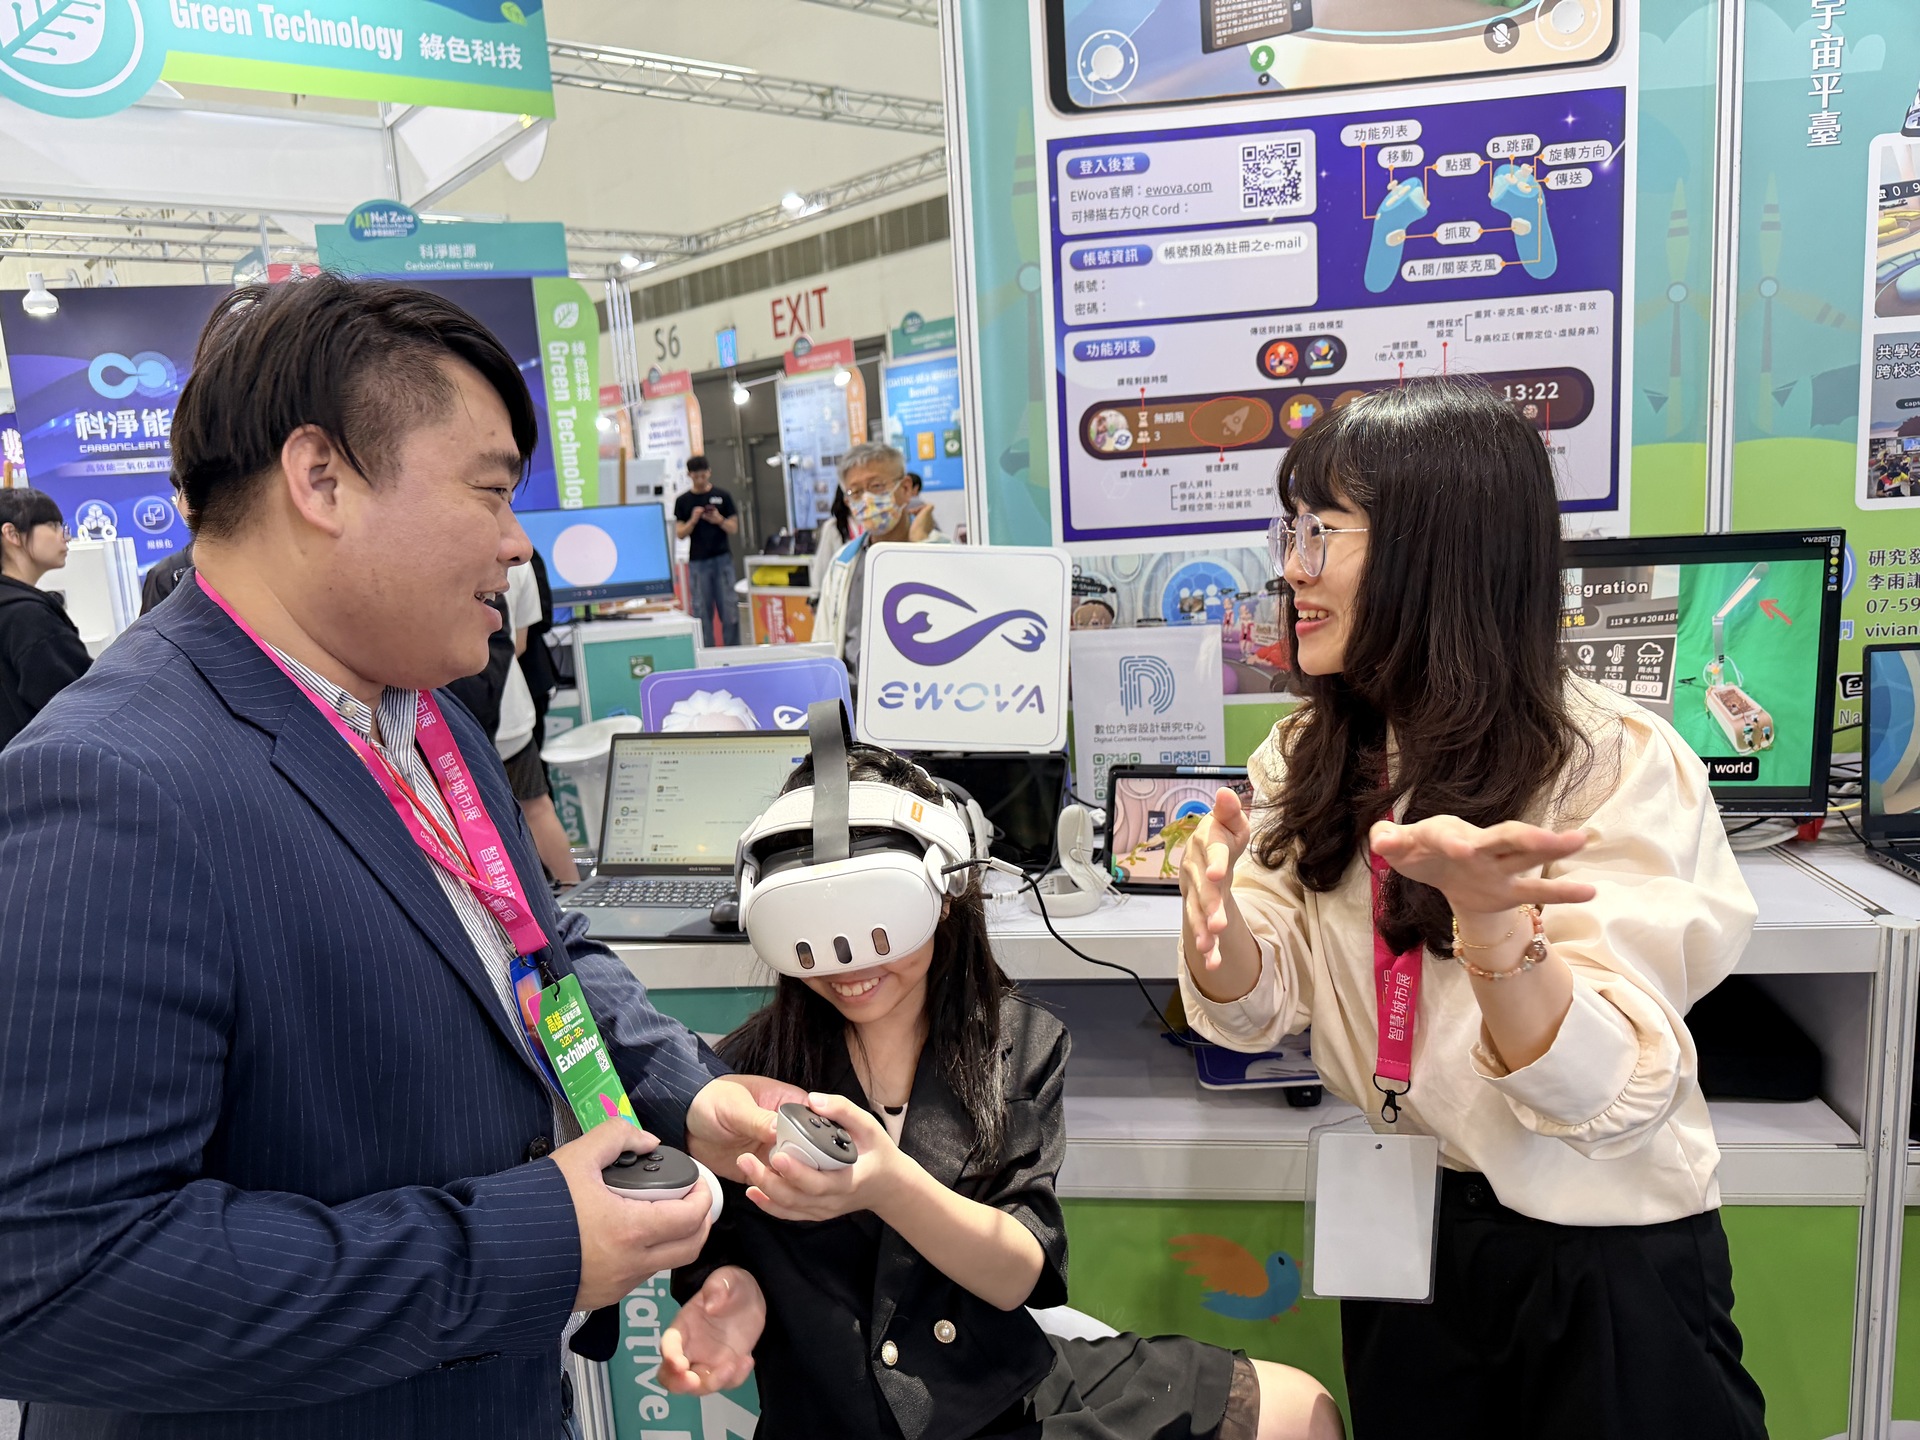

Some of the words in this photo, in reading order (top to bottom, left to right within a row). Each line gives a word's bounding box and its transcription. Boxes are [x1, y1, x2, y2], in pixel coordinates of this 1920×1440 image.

[170, 0, 253, 37] Green
[257, 3, 404, 61] Technology
[418, 32, 523, 71] 綠色科技
[1353, 125, 1408, 142] 功能列表
[1386, 148, 1413, 164] 移動
[1548, 143, 1605, 163] 旋轉方向
[1078, 157, 1136, 175] 登入後臺
[1445, 157, 1472, 171] 點選
[1554, 170, 1583, 185] 傳送
[1445, 226, 1472, 240] 抓取
[418, 243, 477, 260] 科淨能源
[1082, 247, 1139, 267] 帳號資訊
[405, 261, 462, 271] CarbonClean
[463, 260, 494, 271] Energy
[772, 286, 829, 340] EXIT
[655, 325, 680, 360] S6
[1086, 340, 1142, 358] 功能列表
[549, 341, 571, 402] Green
[1503, 381, 1559, 401] 13:22
[75, 408, 172, 441] 科淨能
[1154, 431, 1161, 441] 3
[79, 442, 161, 454] CARBONCLEAN
[556, 406, 585, 508] Technolog
[1566, 580, 1649, 598] tegration
[1865, 622, 1920, 637] vivian
[1839, 710, 1861, 726] Na
[1094, 736, 1113, 744] Digital
[1138, 735, 1159, 743] Design
[1715, 762, 1753, 774] world
[438, 751, 482, 823] 智慧城市展
[1387, 972, 1411, 1042] 智慧城市展
[555, 1033, 600, 1074] Exhibitor
